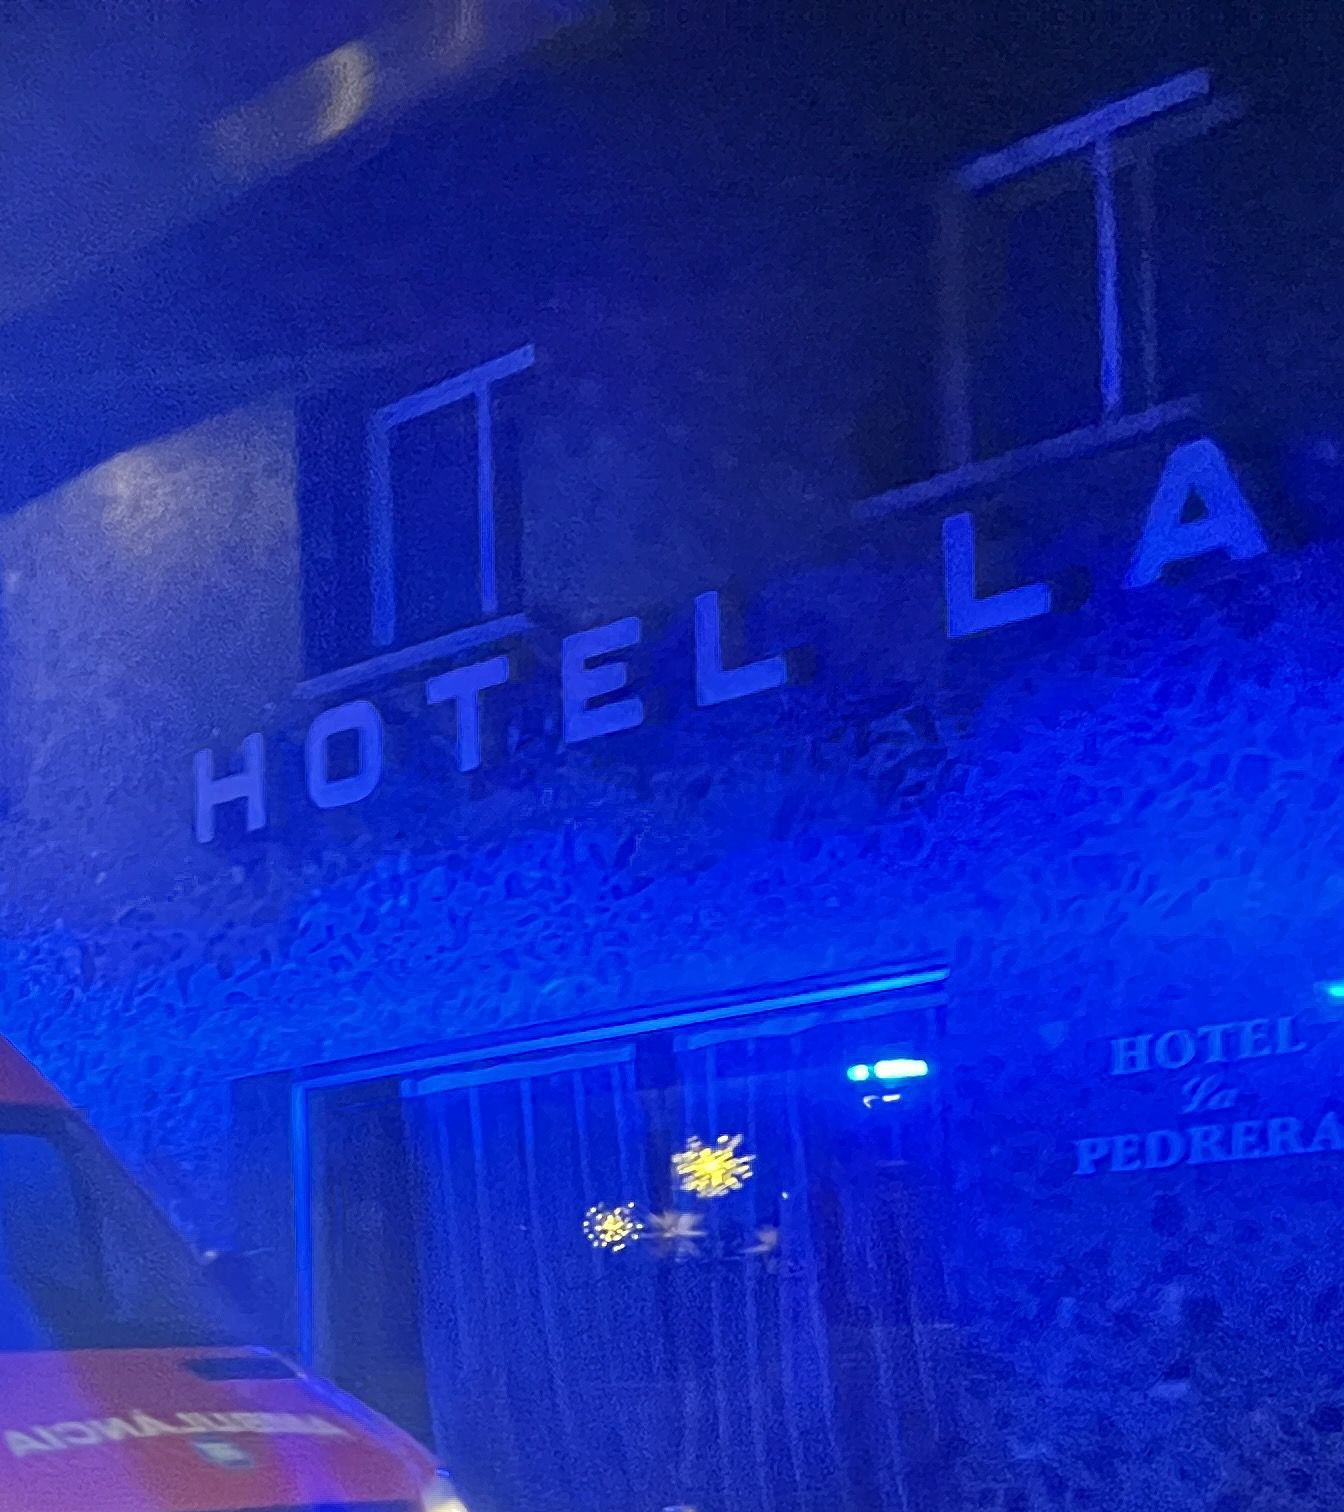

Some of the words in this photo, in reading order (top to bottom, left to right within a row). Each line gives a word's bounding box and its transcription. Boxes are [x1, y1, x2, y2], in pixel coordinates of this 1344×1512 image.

[192, 590, 789, 843] HOTEL
[1111, 1016, 1306, 1075] HOTEL
[1073, 1111, 1344, 1176] PEDRERA
